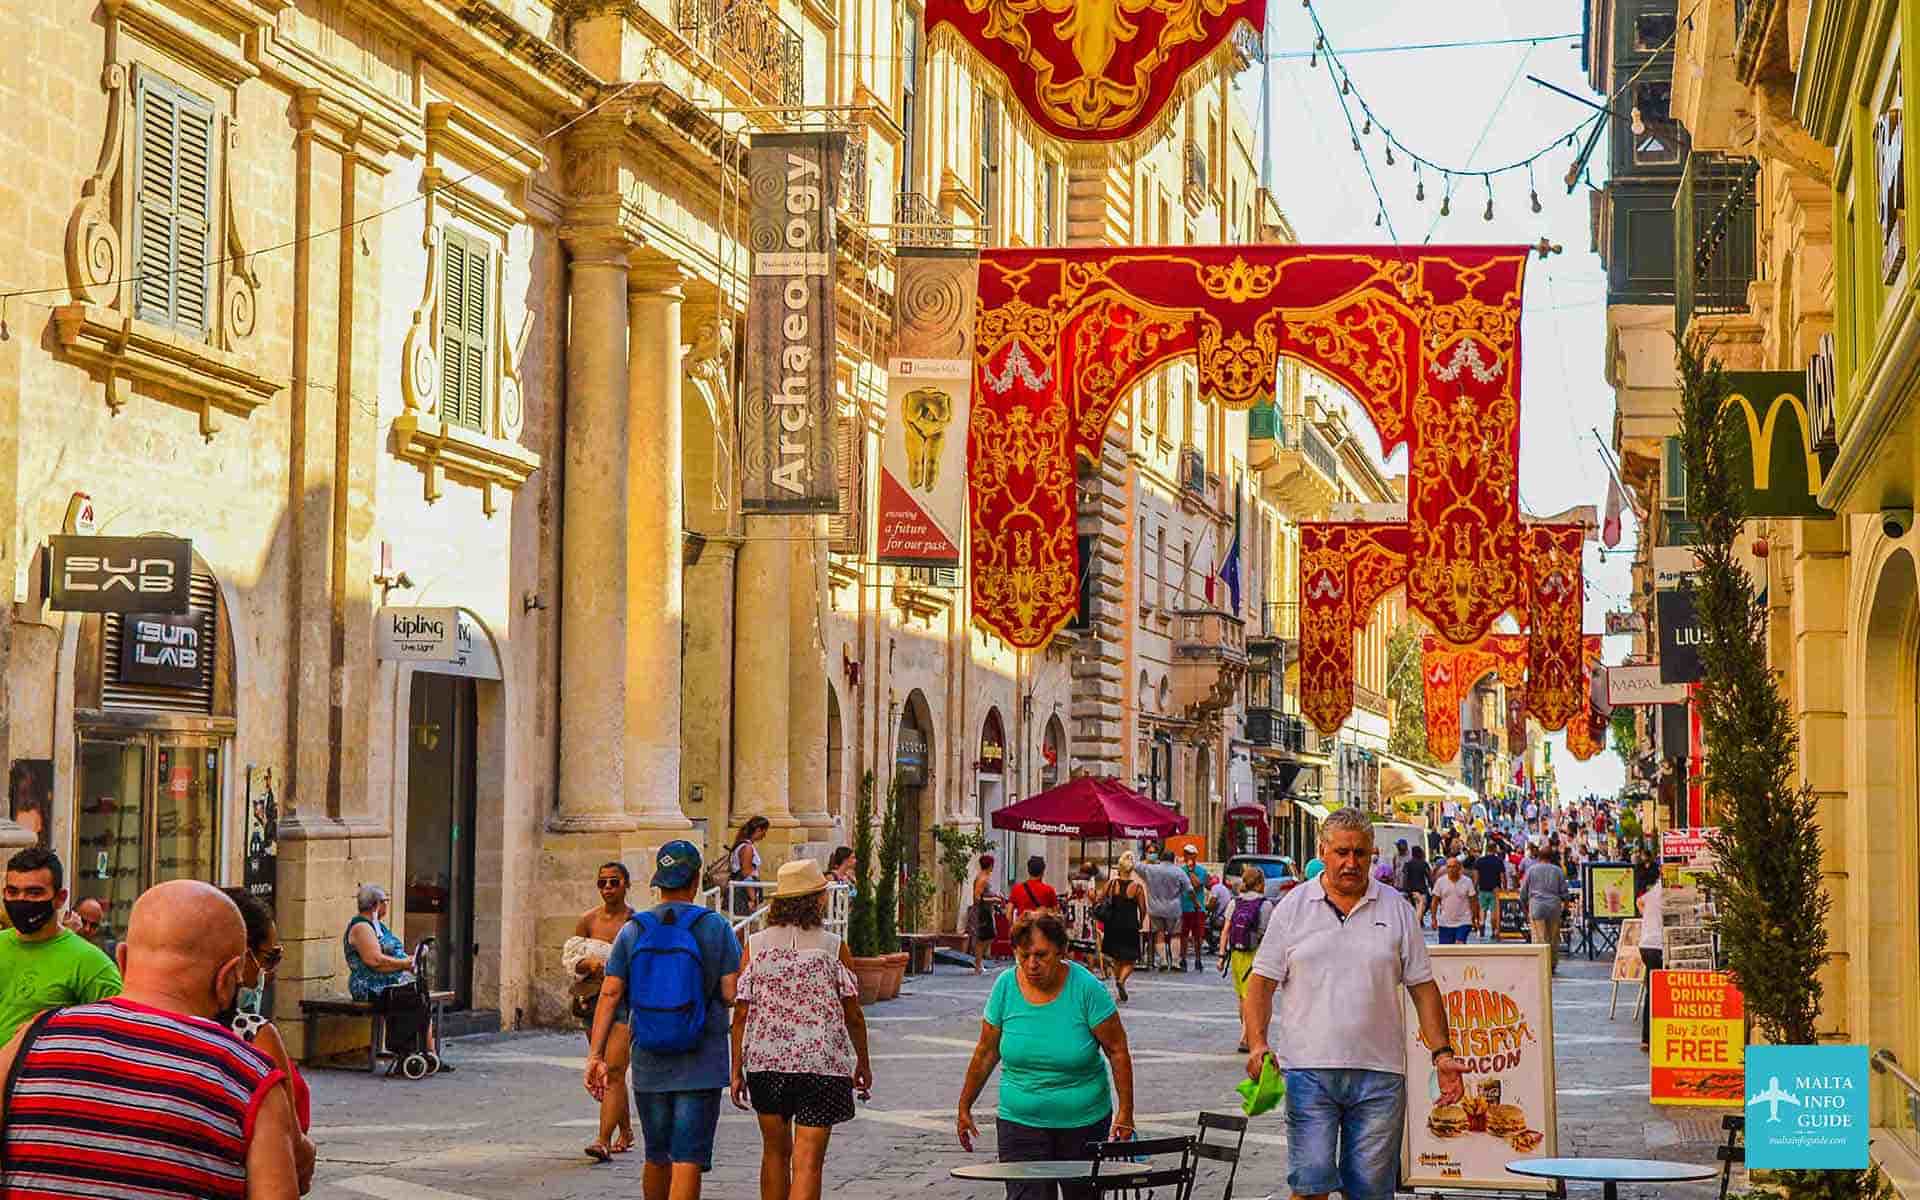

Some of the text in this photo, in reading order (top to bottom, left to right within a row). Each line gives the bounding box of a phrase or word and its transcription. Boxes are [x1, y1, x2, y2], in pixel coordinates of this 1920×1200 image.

[771, 152, 821, 496] Archaeology
[884, 520, 927, 537] a future
[883, 536, 946, 554] for our past
[64, 573, 174, 593] LAB
[136, 621, 198, 647] SUN
[392, 613, 444, 639] kipling
[135, 644, 197, 669] LAB
[1667, 973, 1729, 987] CHILLED
[1671, 988, 1726, 1002] DRINKS
[1441, 988, 1521, 1027] RAND
[1673, 1003, 1723, 1017] INSIDE
[1665, 1024, 1688, 1039] Buy
[1691, 1024, 1698, 1036] 2
[1701, 1024, 1720, 1036] Get
[1665, 1039, 1729, 1063] FREE
